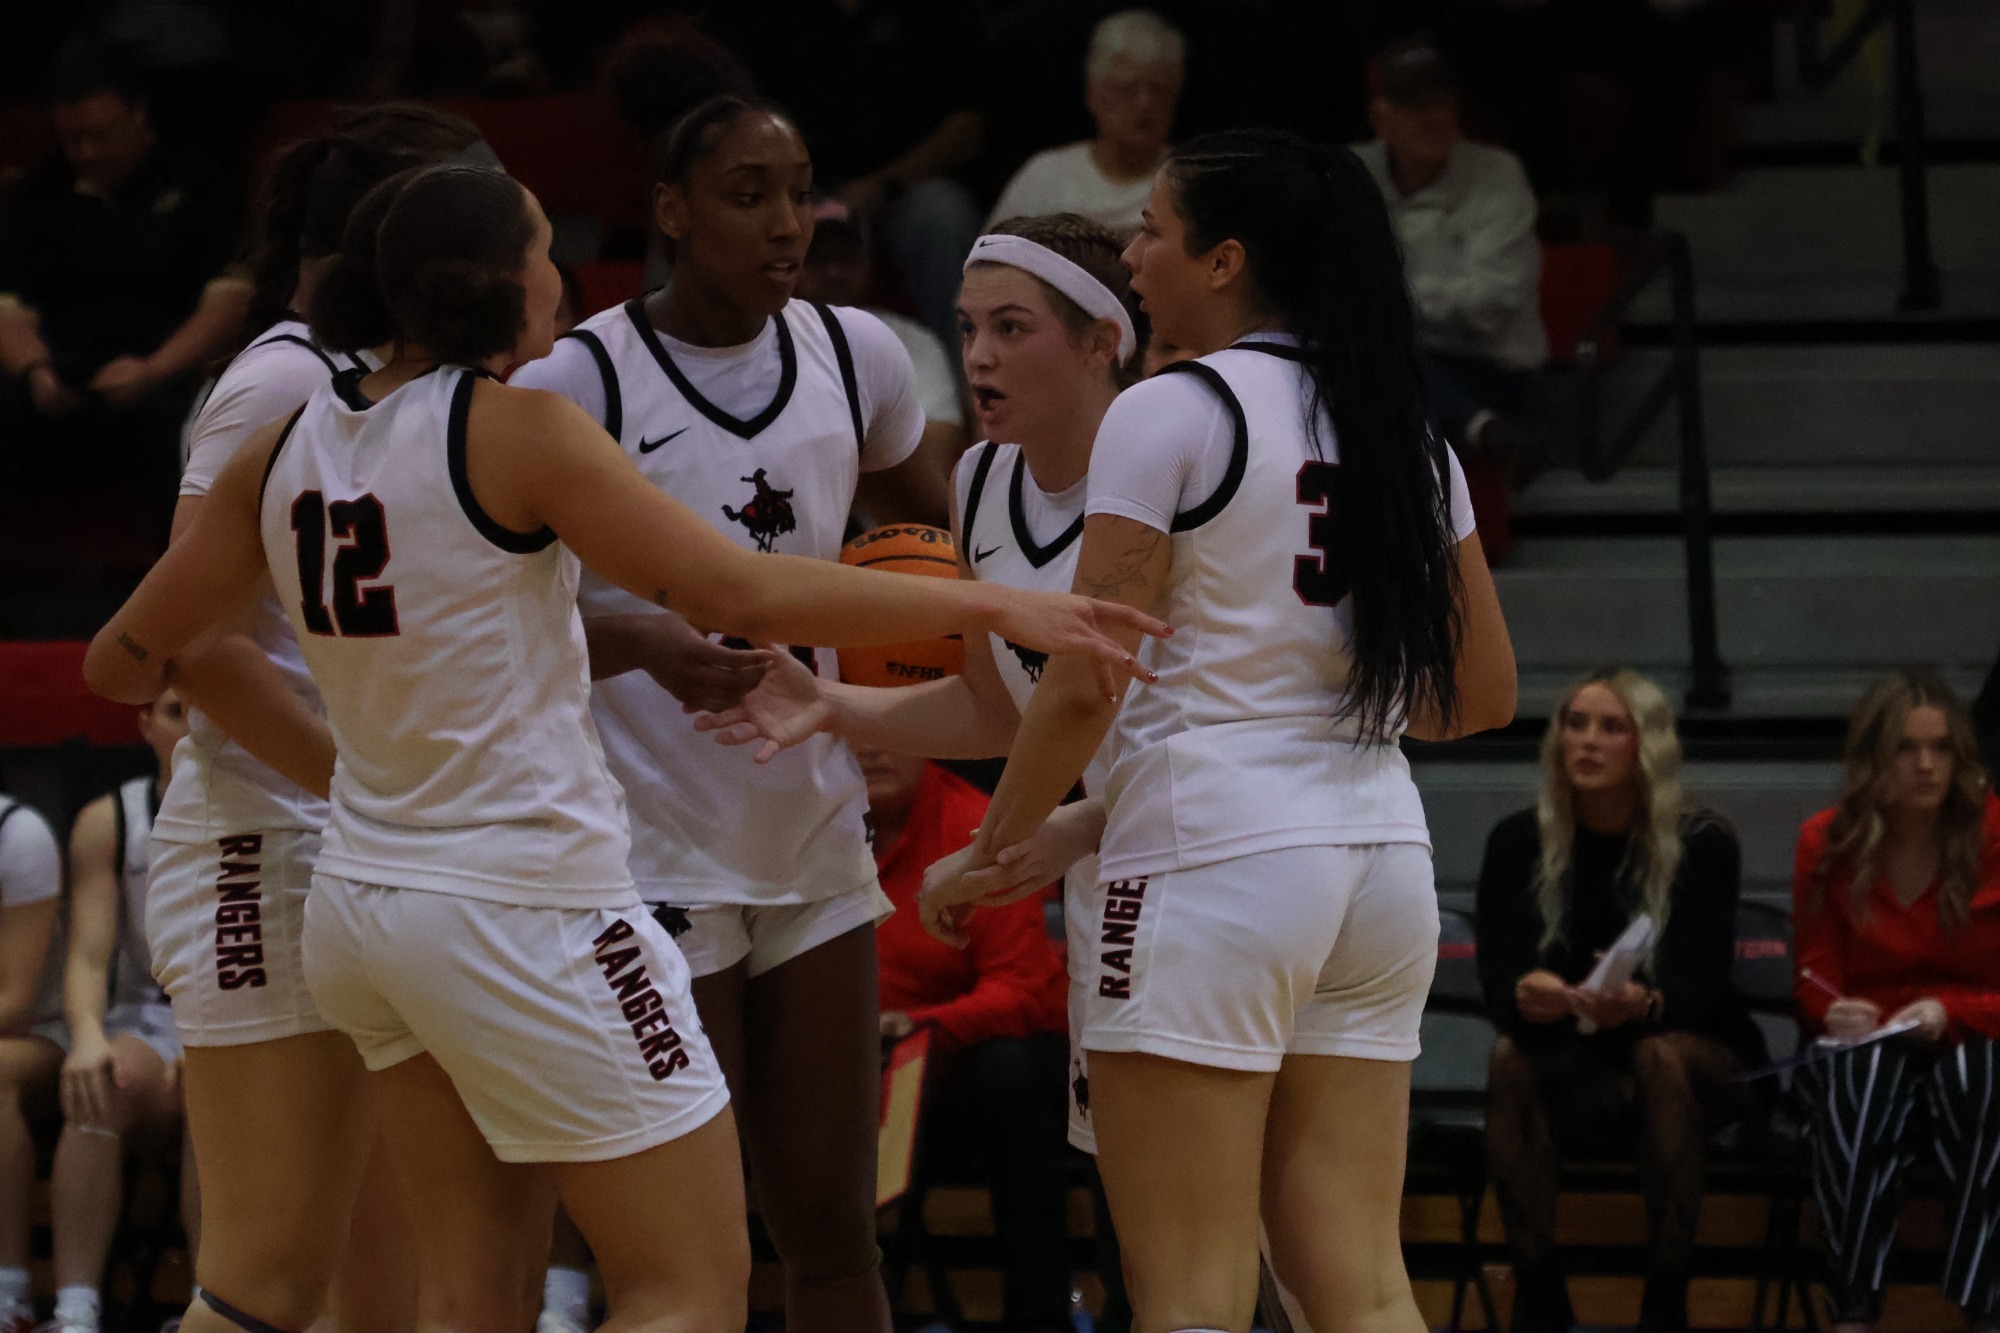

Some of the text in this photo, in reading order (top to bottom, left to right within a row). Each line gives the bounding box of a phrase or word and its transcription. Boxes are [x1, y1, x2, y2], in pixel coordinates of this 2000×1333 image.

[291, 489, 400, 637] 12
[1293, 459, 1352, 608] 3
[215, 834, 267, 990] RANGERS
[1099, 875, 1149, 1000] RANGE
[592, 918, 690, 1081] RANGERS
